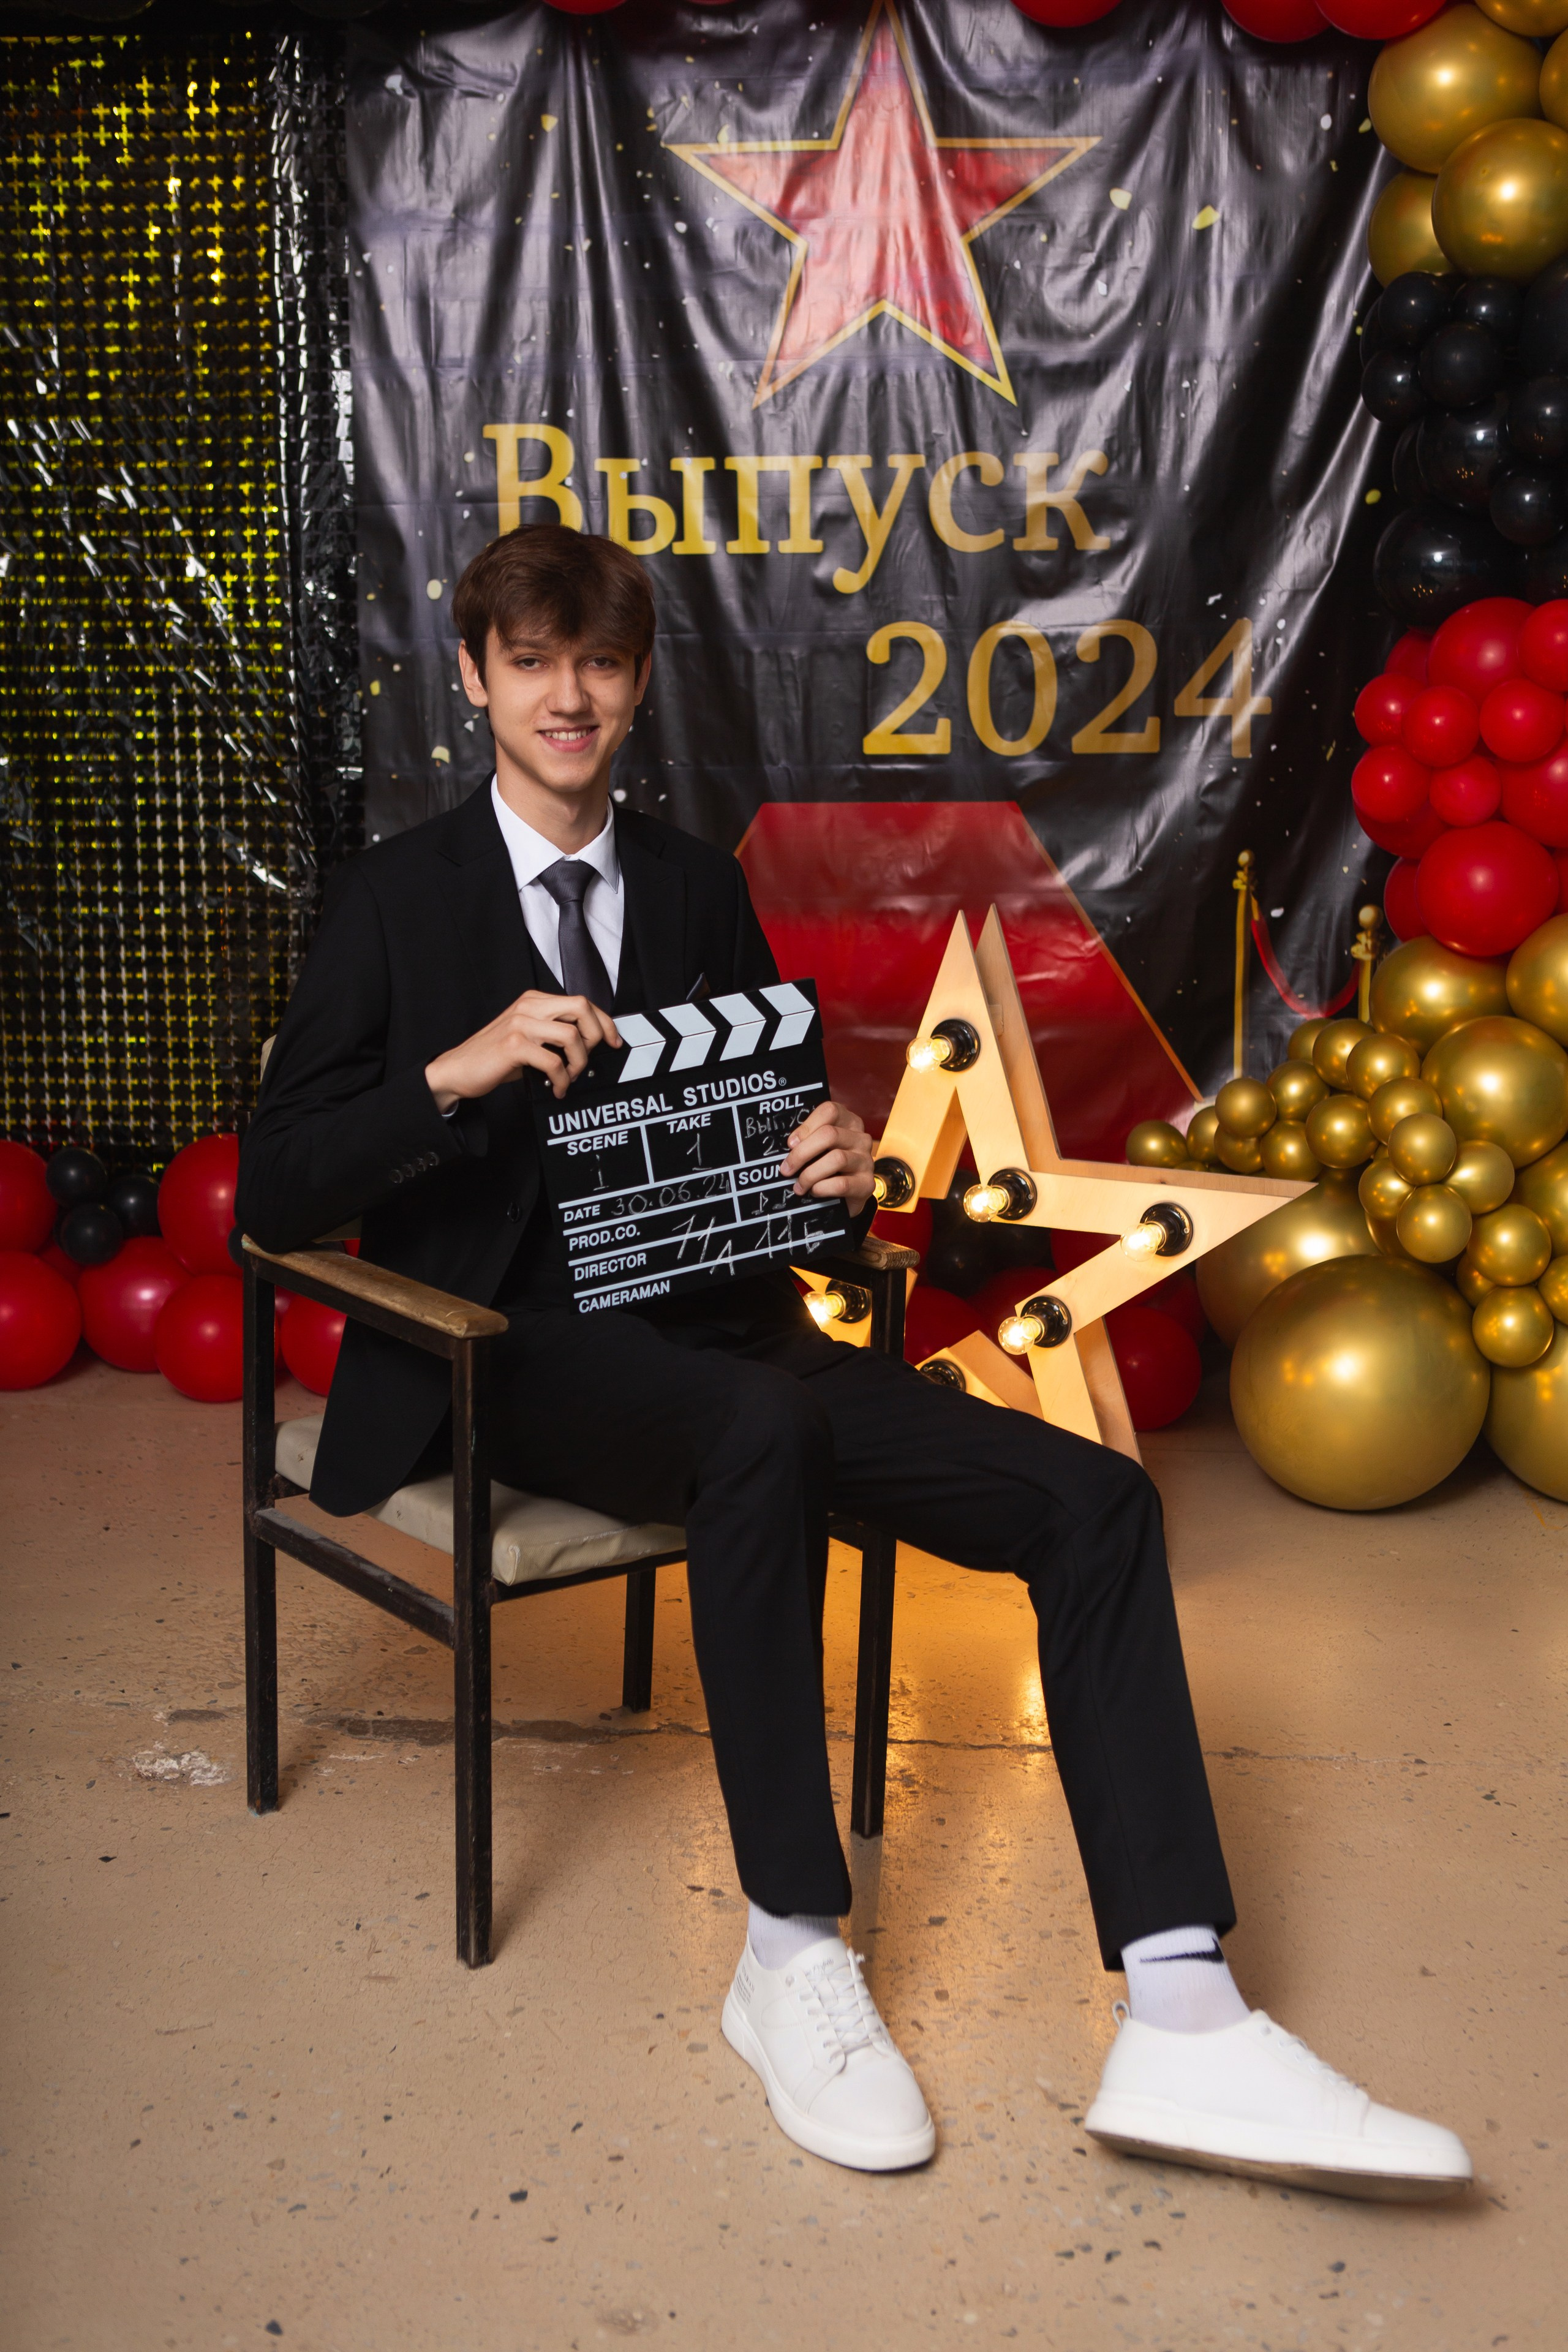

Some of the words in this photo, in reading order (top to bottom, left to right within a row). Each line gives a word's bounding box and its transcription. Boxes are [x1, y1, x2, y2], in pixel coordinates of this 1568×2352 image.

[482, 423, 1111, 594] Выпуск
[862, 617, 1273, 760] 2024
[549, 1093, 673, 1134] UNIVERSAL
[759, 1095, 804, 1115] ROLL
[666, 1113, 711, 1134] TAKE
[567, 1131, 628, 1156] SCENE
[687, 1133, 712, 1171] 1
[564, 1205, 600, 1223] DATE
[569, 1224, 641, 1251] PROD.CO.
[575, 1253, 647, 1281] DIRECTOR
[579, 1280, 670, 1313] CAMERAMAN
